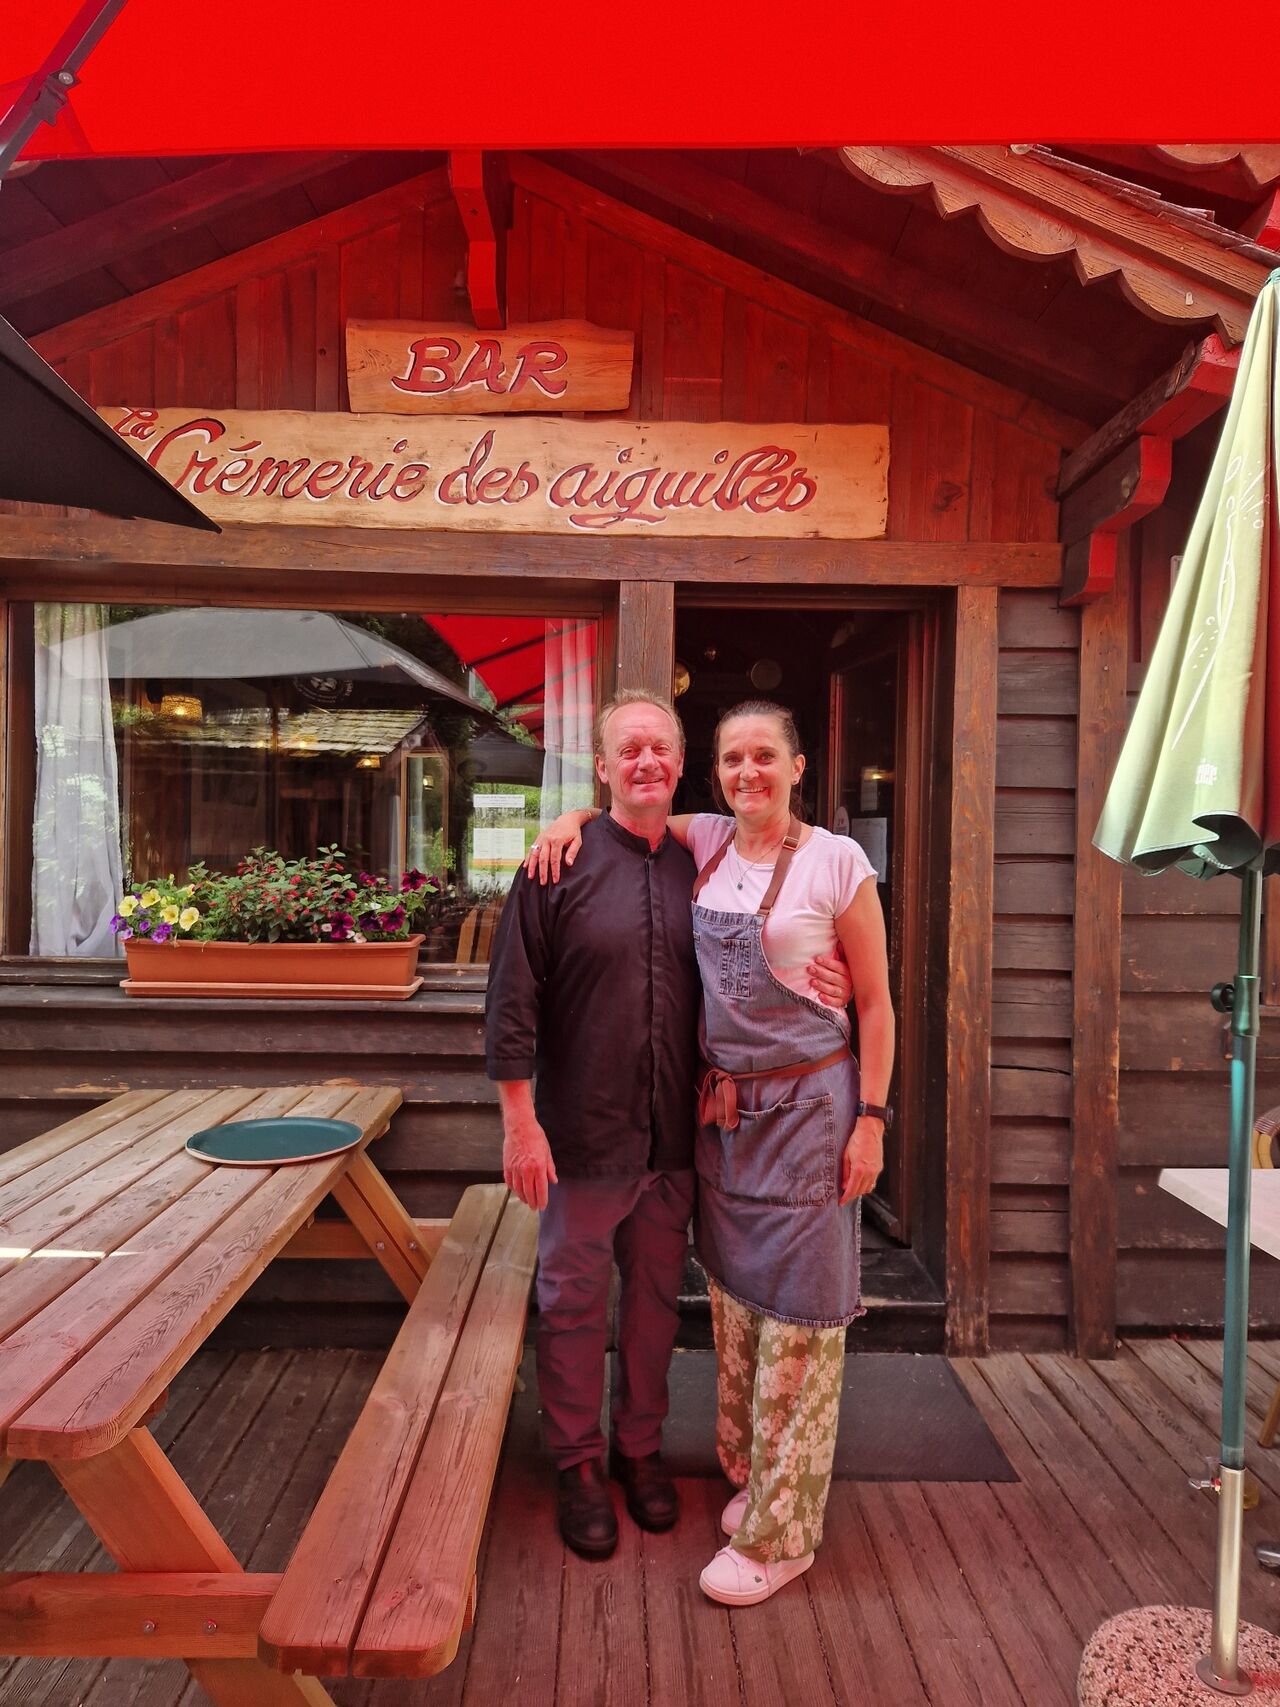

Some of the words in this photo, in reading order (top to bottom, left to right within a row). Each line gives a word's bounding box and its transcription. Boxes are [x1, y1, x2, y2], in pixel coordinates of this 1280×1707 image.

[391, 337, 568, 399] BAR
[113, 406, 159, 442] La
[145, 418, 431, 503] Crémerie
[435, 429, 540, 506] des
[548, 445, 817, 530] aiguilles
